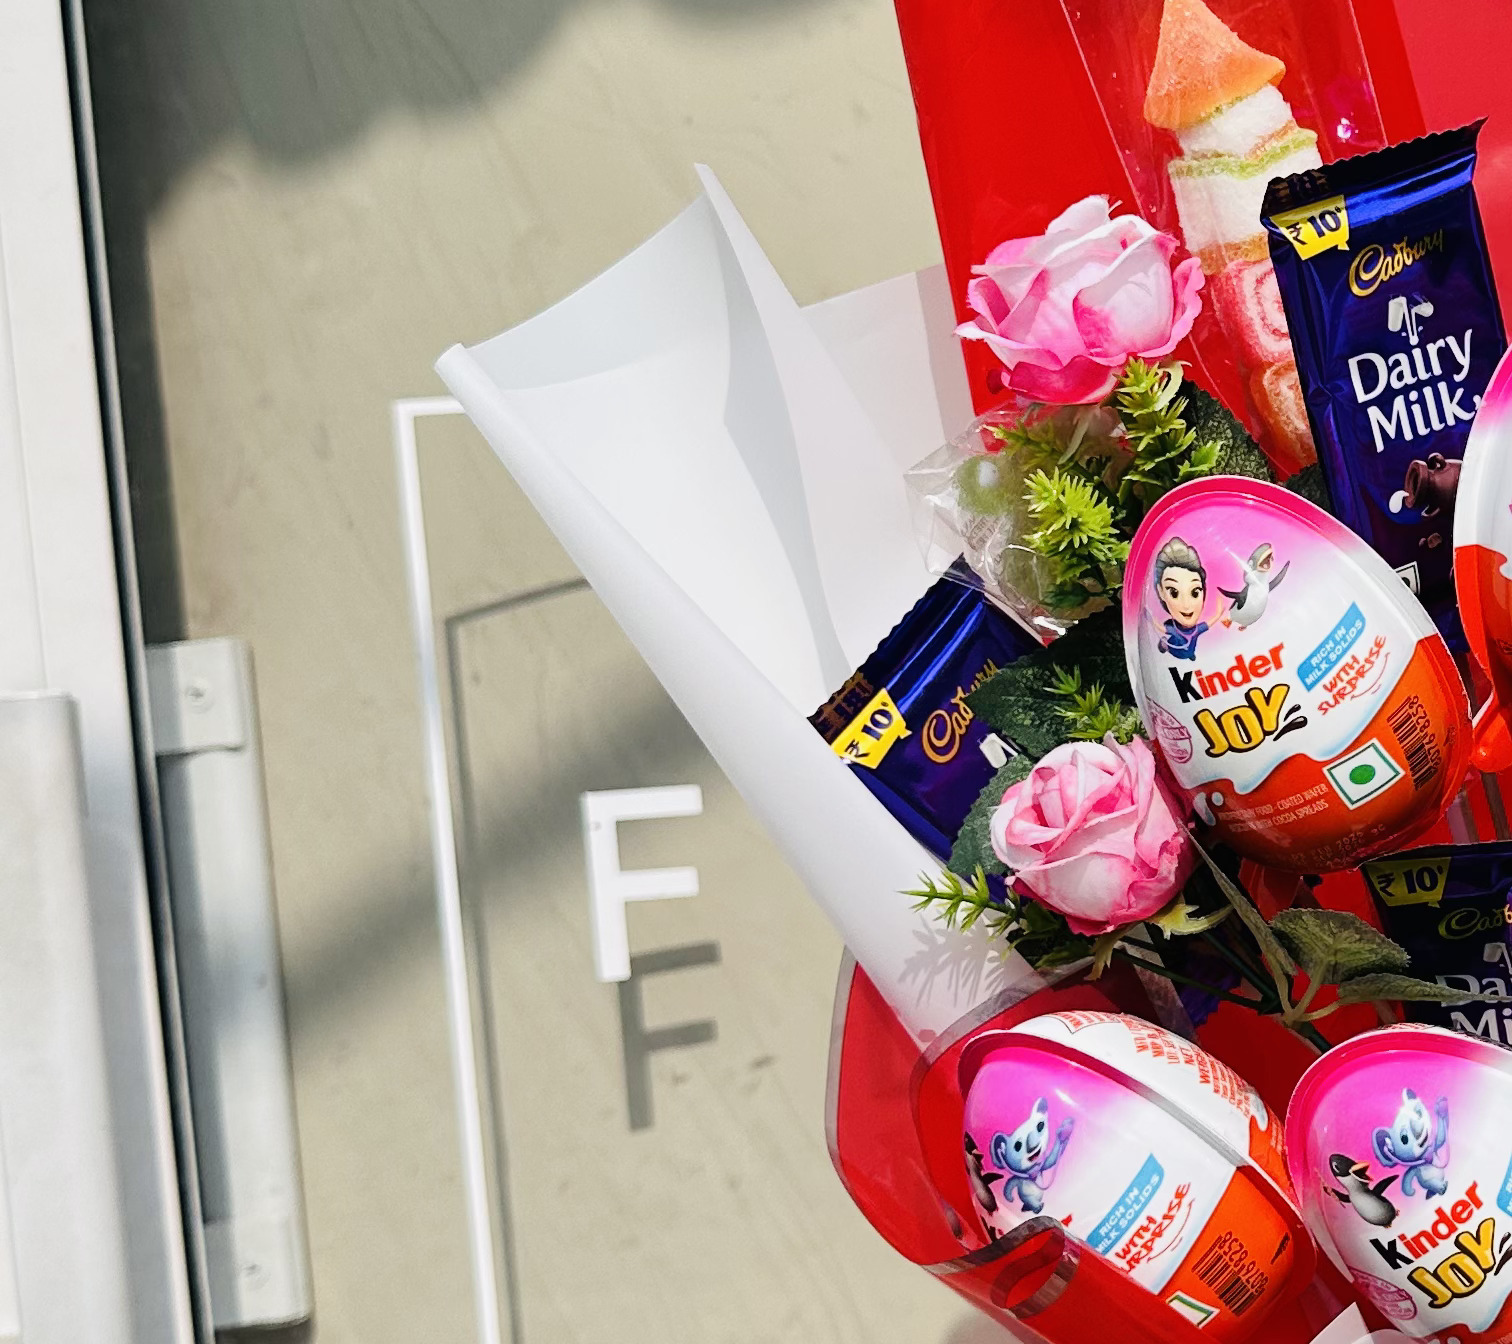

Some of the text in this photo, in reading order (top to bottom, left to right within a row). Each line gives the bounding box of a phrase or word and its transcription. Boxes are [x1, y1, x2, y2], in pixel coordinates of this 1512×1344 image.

[1350, 229, 1444, 298] Cadbury
[1348, 328, 1473, 404] Dairy
[1305, 619, 1363, 687] MILK SOLIDS
[1310, 625, 1348, 667] RICH IN
[1317, 634, 1387, 716] SURPRISE
[1322, 655, 1361, 693] WITH
[1192, 683, 1290, 759] JOY
[1100, 1186, 1140, 1237] RICH IN
[1120, 1173, 1160, 1229] SOLIDS
[1115, 1215, 1157, 1260] WITH
[1407, 1217, 1497, 1309] JOY
